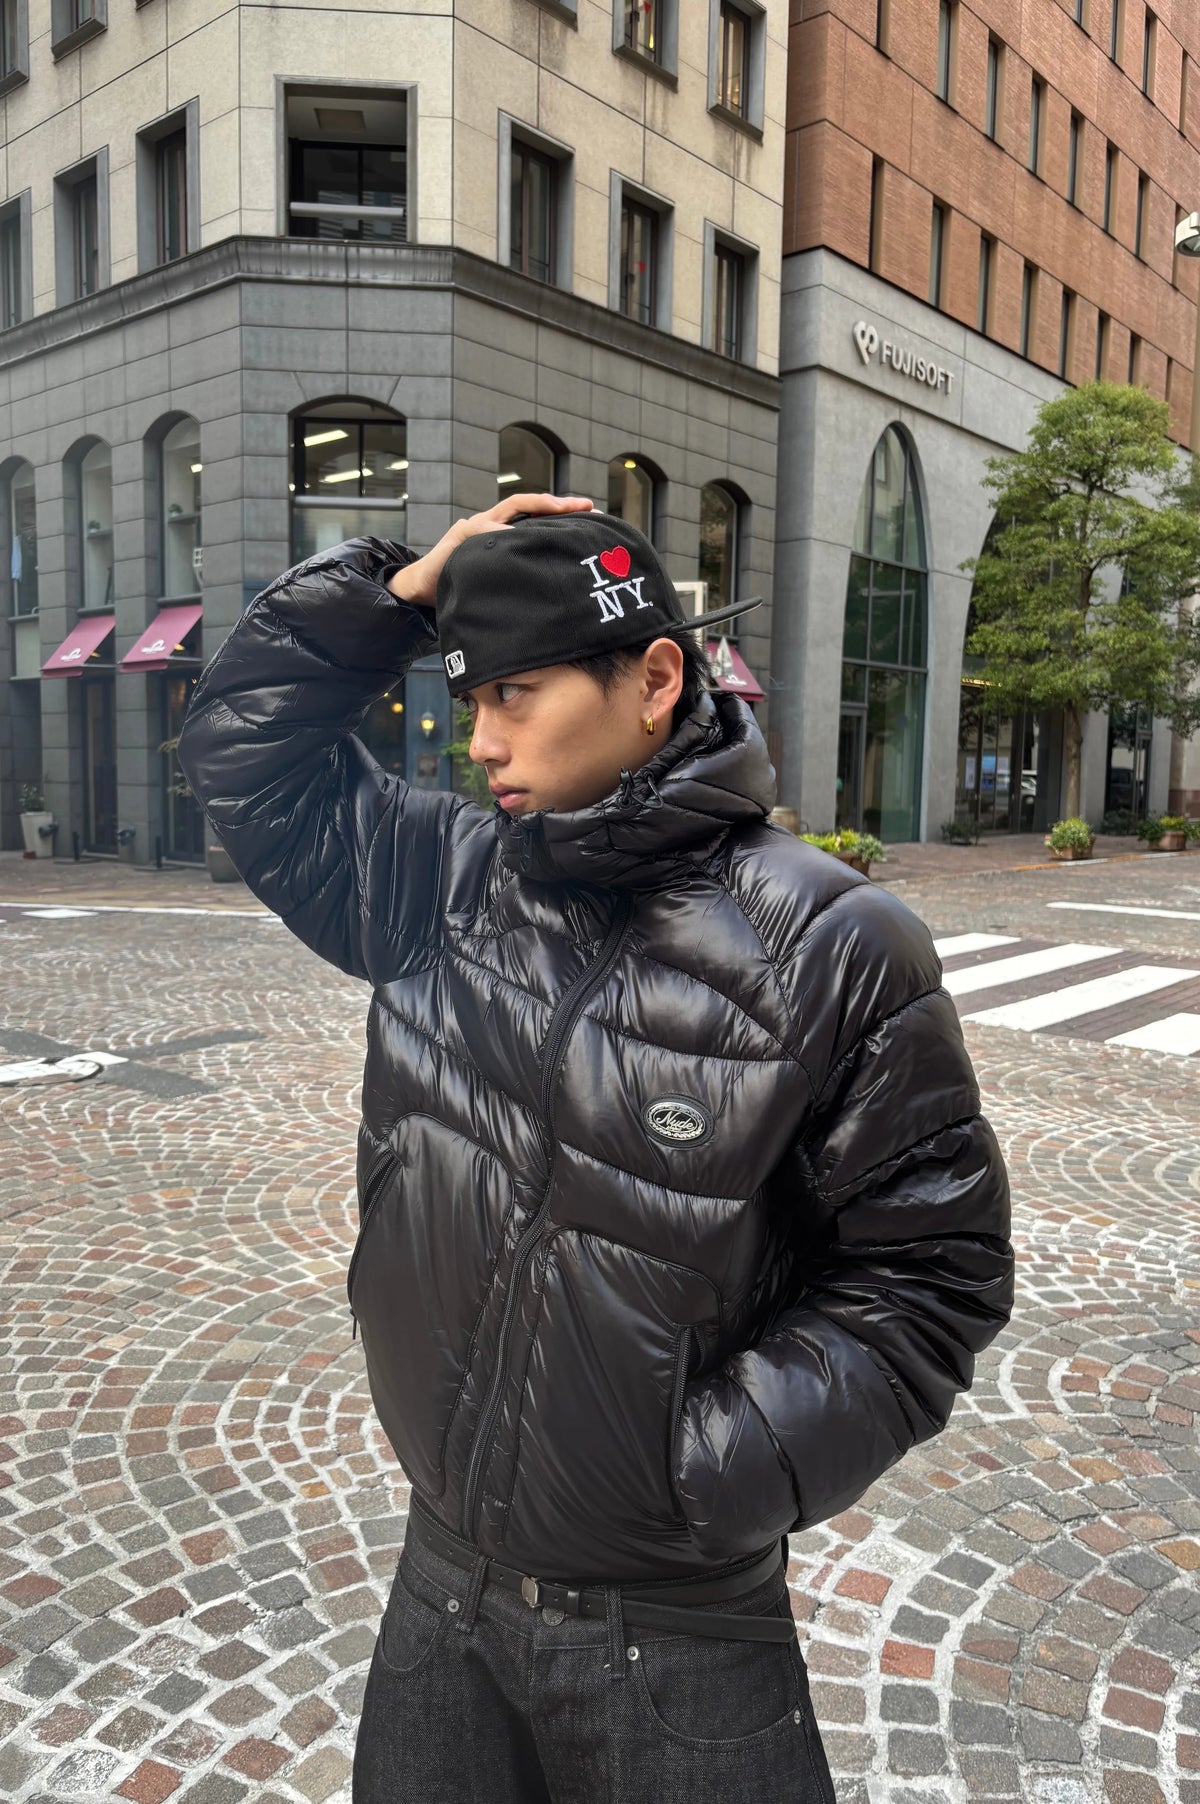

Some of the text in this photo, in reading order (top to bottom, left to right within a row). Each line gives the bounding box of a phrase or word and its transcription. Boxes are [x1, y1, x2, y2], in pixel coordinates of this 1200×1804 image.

[881, 340, 954, 395] FUJISOFT
[580, 555, 610, 588] I
[655, 1110, 695, 1129] Nude
